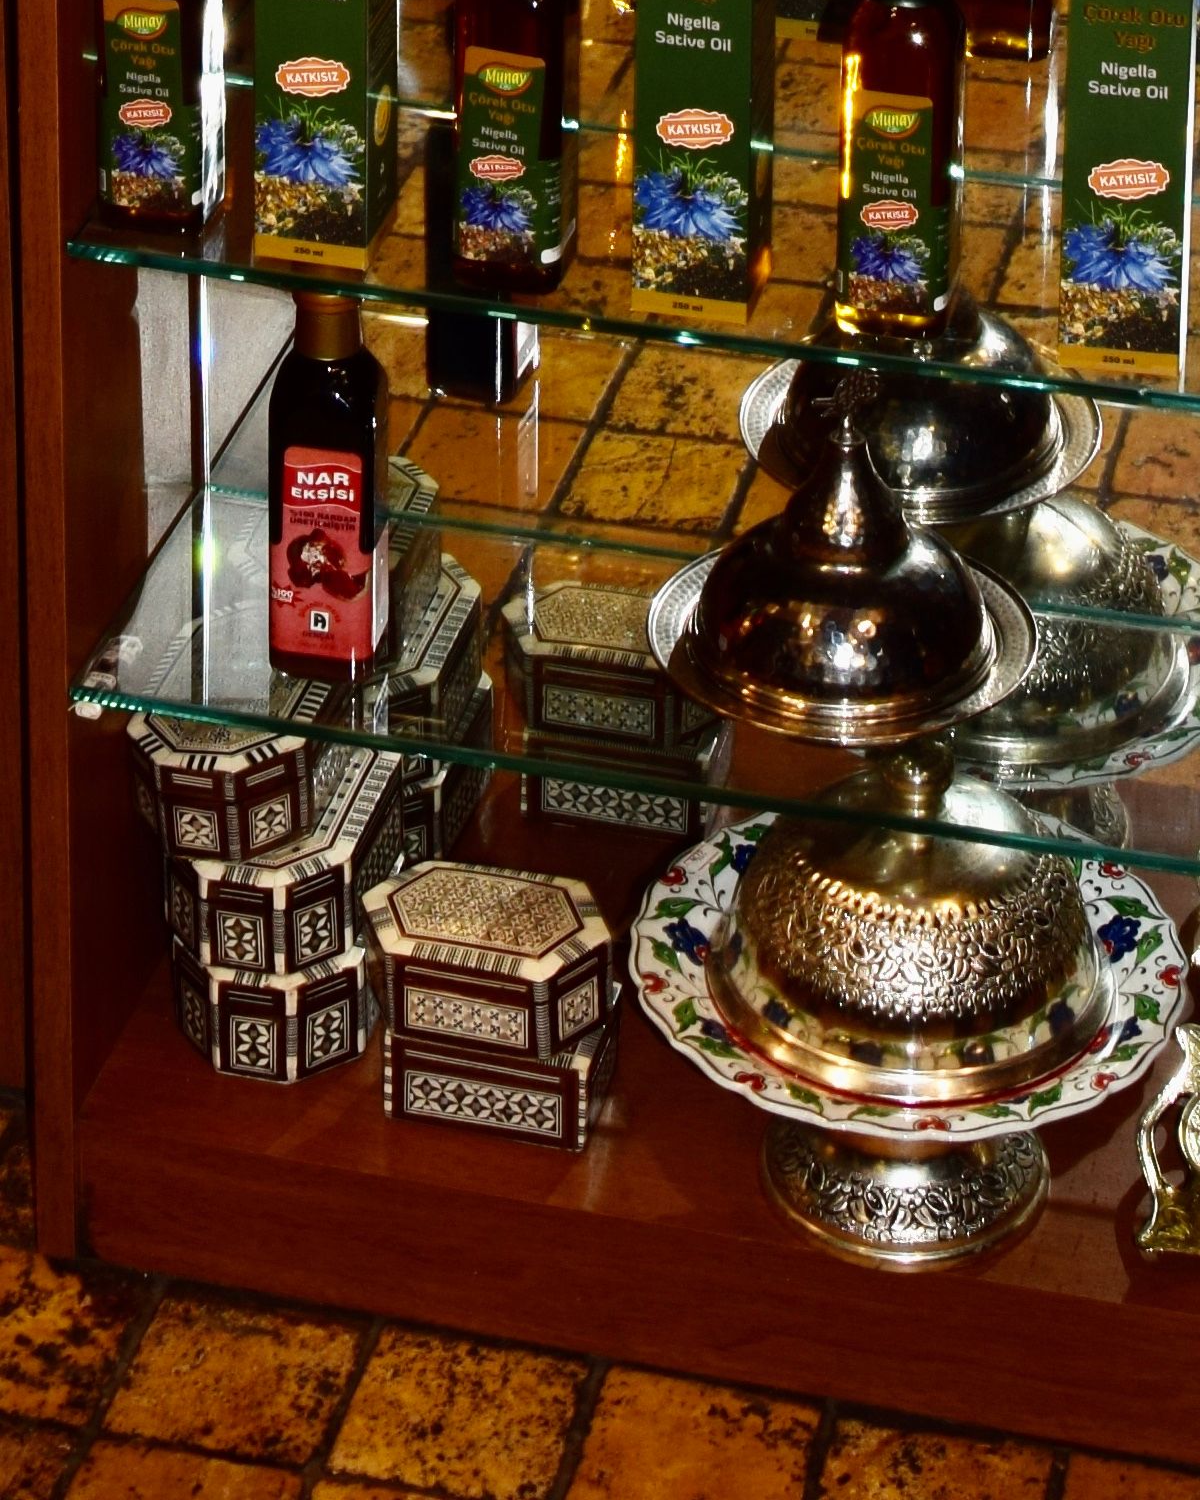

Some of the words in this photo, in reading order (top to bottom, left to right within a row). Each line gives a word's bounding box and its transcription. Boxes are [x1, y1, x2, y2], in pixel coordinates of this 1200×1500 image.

[124, 14, 163, 29] Munay
[667, 12, 720, 31] Nigella
[655, 30, 706, 49] Sative
[710, 37, 732, 52] Oil
[285, 71, 339, 84] KATKISIZ
[485, 68, 527, 87] Munay
[1101, 61, 1157, 80] Nigella
[119, 83, 152, 96] Sative
[155, 87, 169, 97] Oil
[1088, 80, 1141, 98] Sative
[1146, 85, 1168, 100] Oil
[872, 112, 915, 129] Munay
[667, 123, 723, 136] KATKISIZ
[472, 138, 507, 153] Sative
[509, 144, 525, 156] Oil
[1099, 172, 1158, 188] KATKISIZ
[862, 183, 899, 197] Sative
[901, 188, 917, 199] Oil
[297, 471, 350, 487] NAR
[291, 486, 355, 503] EKŞİSİ
